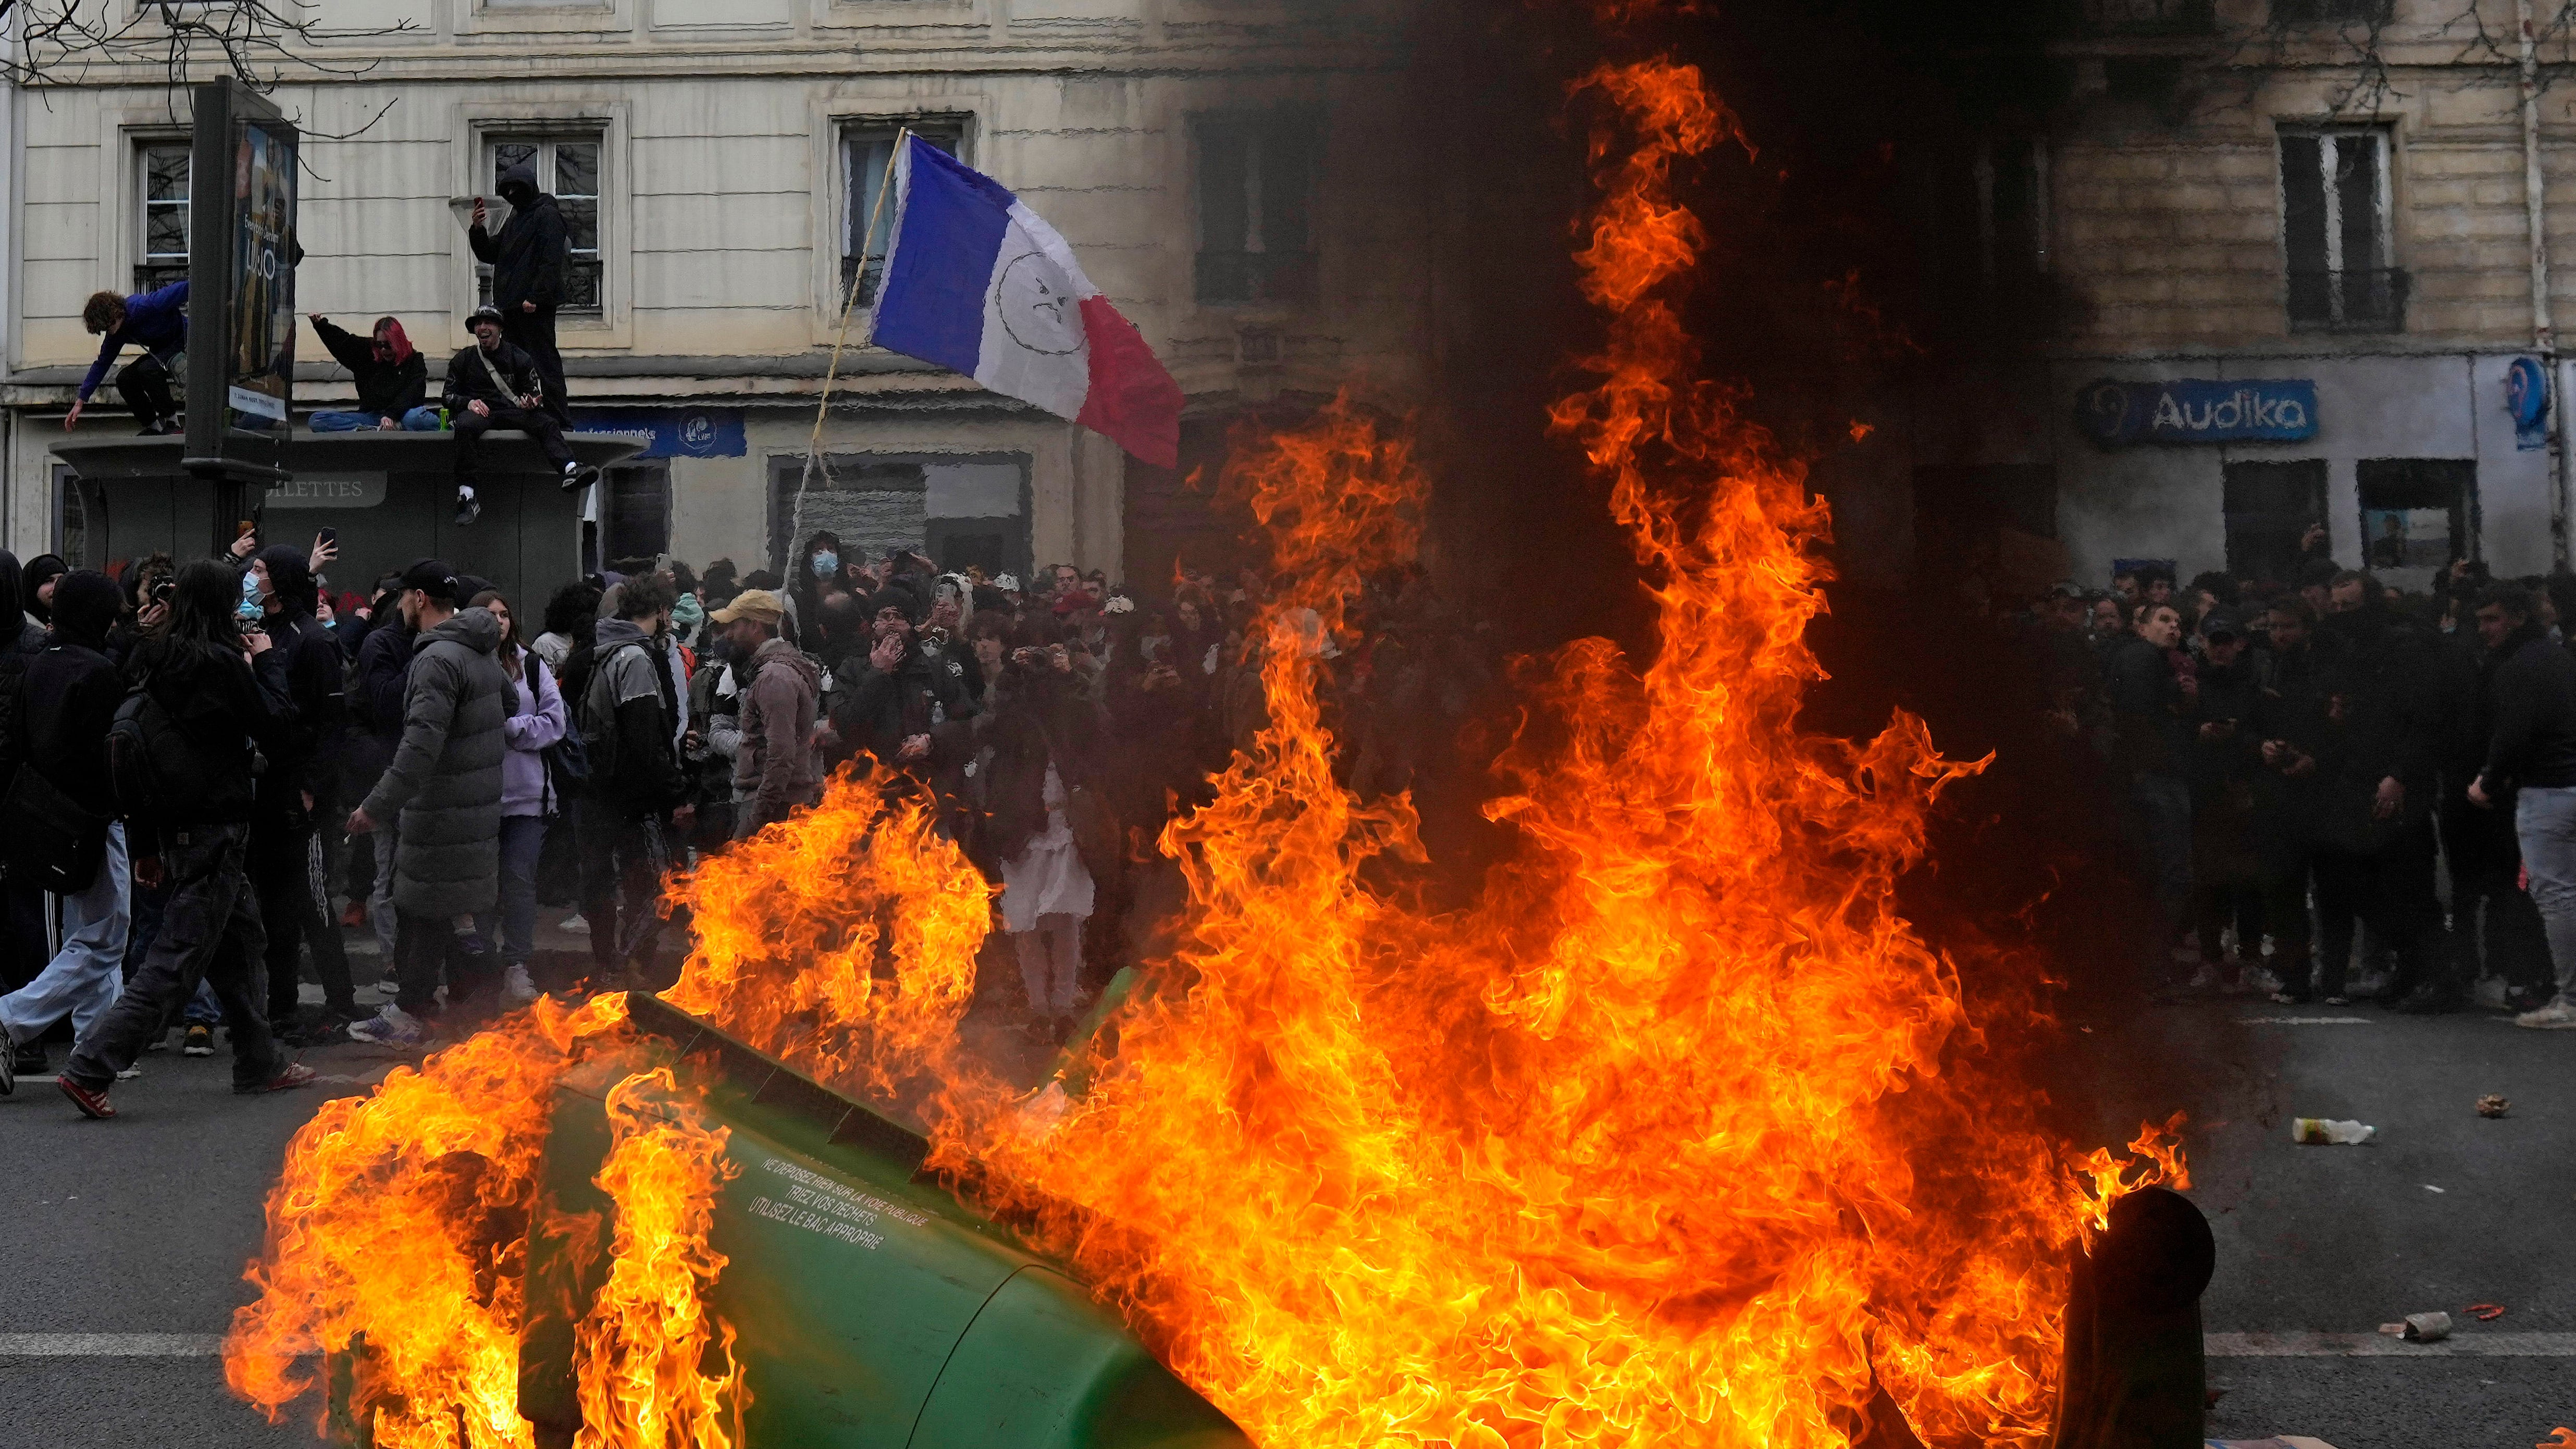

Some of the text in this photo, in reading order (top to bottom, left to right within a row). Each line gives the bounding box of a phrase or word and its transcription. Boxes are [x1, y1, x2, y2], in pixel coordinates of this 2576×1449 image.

[2152, 390, 2307, 430] Audika
[761, 1157, 779, 1171] NE
[811, 1175, 837, 1191] RIEN
[832, 1184, 854, 1198] SUR
[849, 1191, 866, 1203] LA
[863, 1196, 888, 1211] VOIE
[882, 1204, 928, 1227] PUBLIQUE
[785, 1184, 816, 1205] TRIEZ
[811, 1193, 836, 1211] VOS
[748, 1196, 795, 1222] UTILISEZ
[788, 1208, 808, 1225] LE
[802, 1213, 828, 1232] BAC
